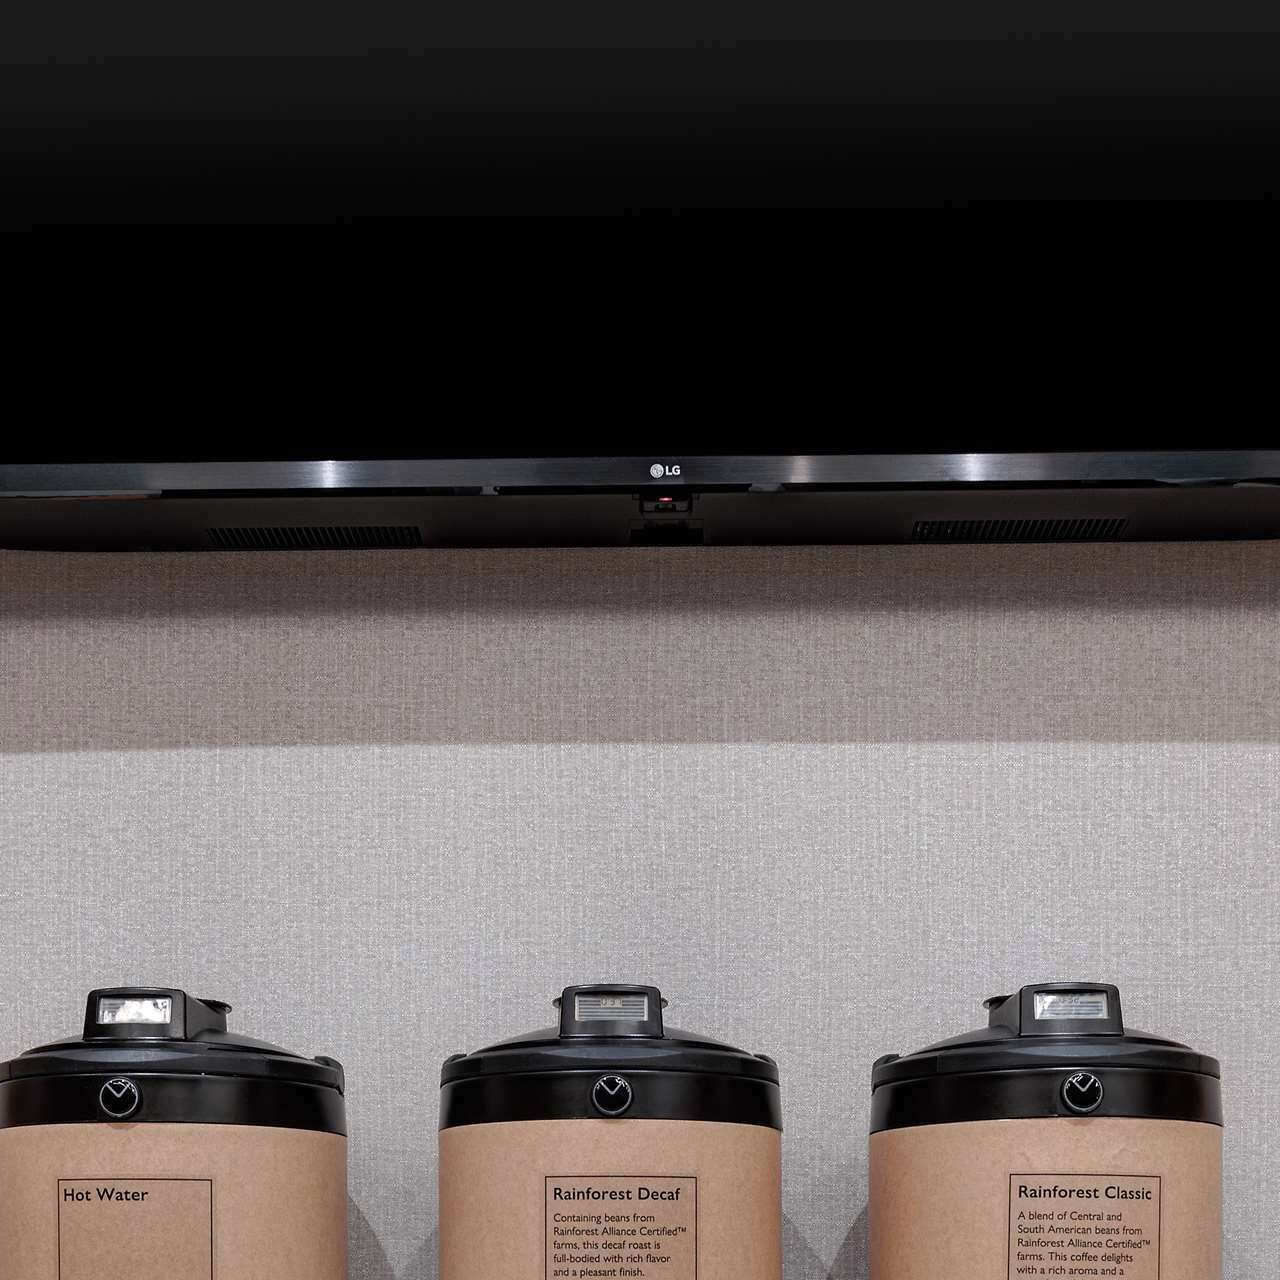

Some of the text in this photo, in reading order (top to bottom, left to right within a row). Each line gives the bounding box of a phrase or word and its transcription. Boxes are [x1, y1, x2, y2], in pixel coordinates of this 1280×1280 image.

[665, 465, 681, 475] LG
[64, 1187, 148, 1201] Hot Water
[553, 1187, 680, 1201] Rainforest Decaf
[1018, 1185, 1152, 1200] Rainforest Classic
[553, 1213, 655, 1224] Containing beans from
[1018, 1211, 1122, 1221] A blend of Central and
[553, 1227, 598, 1236] Rainforest
[601, 1227, 636, 1236] Alliance
[1018, 1224, 1143, 1235] South American beans from
[553, 1240, 661, 1250] farms, this decaf roast is
[1017, 1238, 1064, 1248] Rainforest
[1067, 1239, 1102, 1248] Alliance
[553, 1254, 671, 1263] full-bodied with rich flavor
[1017, 1252, 1134, 1264] farms. This coffee delights
[553, 1268, 569, 1277] and
[580, 1268, 617, 1278] pleasant
[619, 1268, 645, 1277] finish.
[1017, 1266, 1037, 1275] with
[1048, 1266, 1066, 1275] rich
[1100, 1266, 1117, 1276] and
